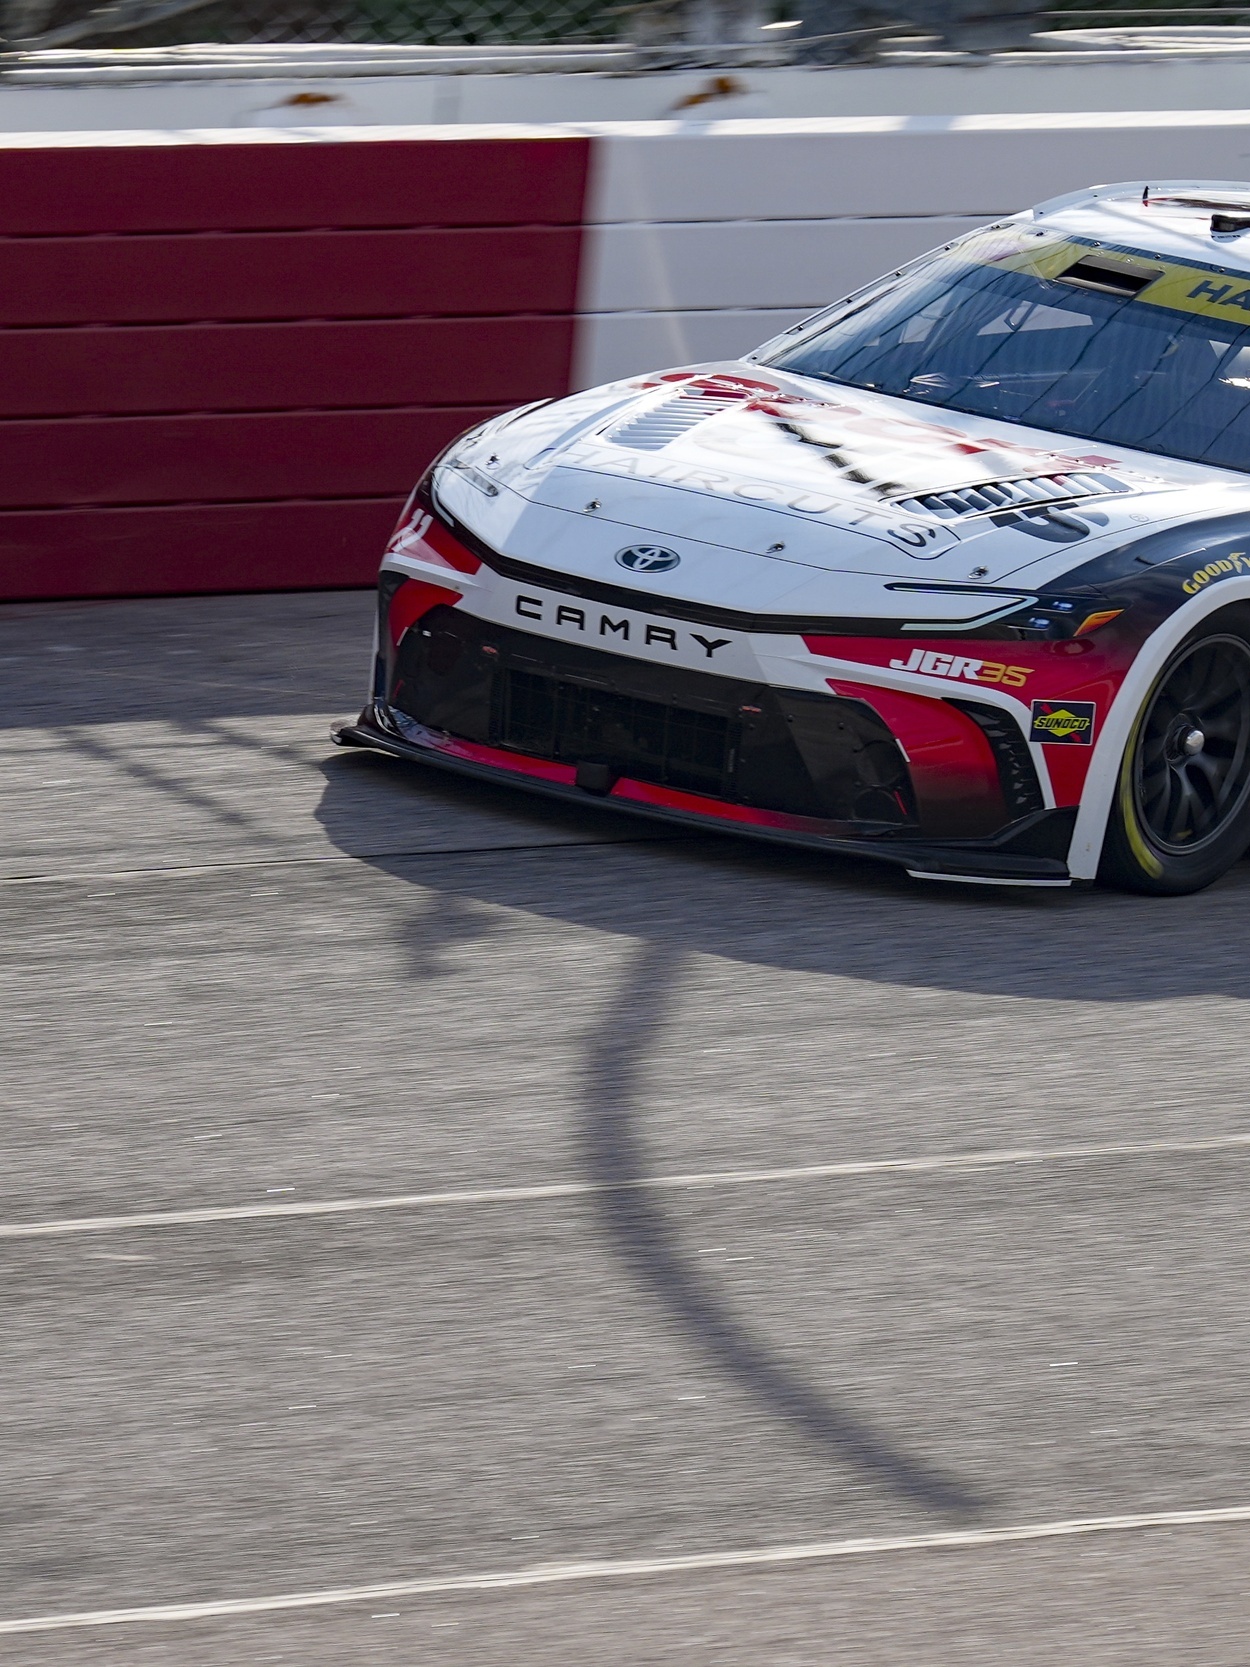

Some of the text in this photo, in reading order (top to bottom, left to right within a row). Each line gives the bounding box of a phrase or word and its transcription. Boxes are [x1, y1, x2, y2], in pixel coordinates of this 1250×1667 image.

[548, 448, 936, 548] HAIRCUTS
[515, 594, 733, 658] CAMRY
[1035, 717, 1090, 731] SUNOCO
